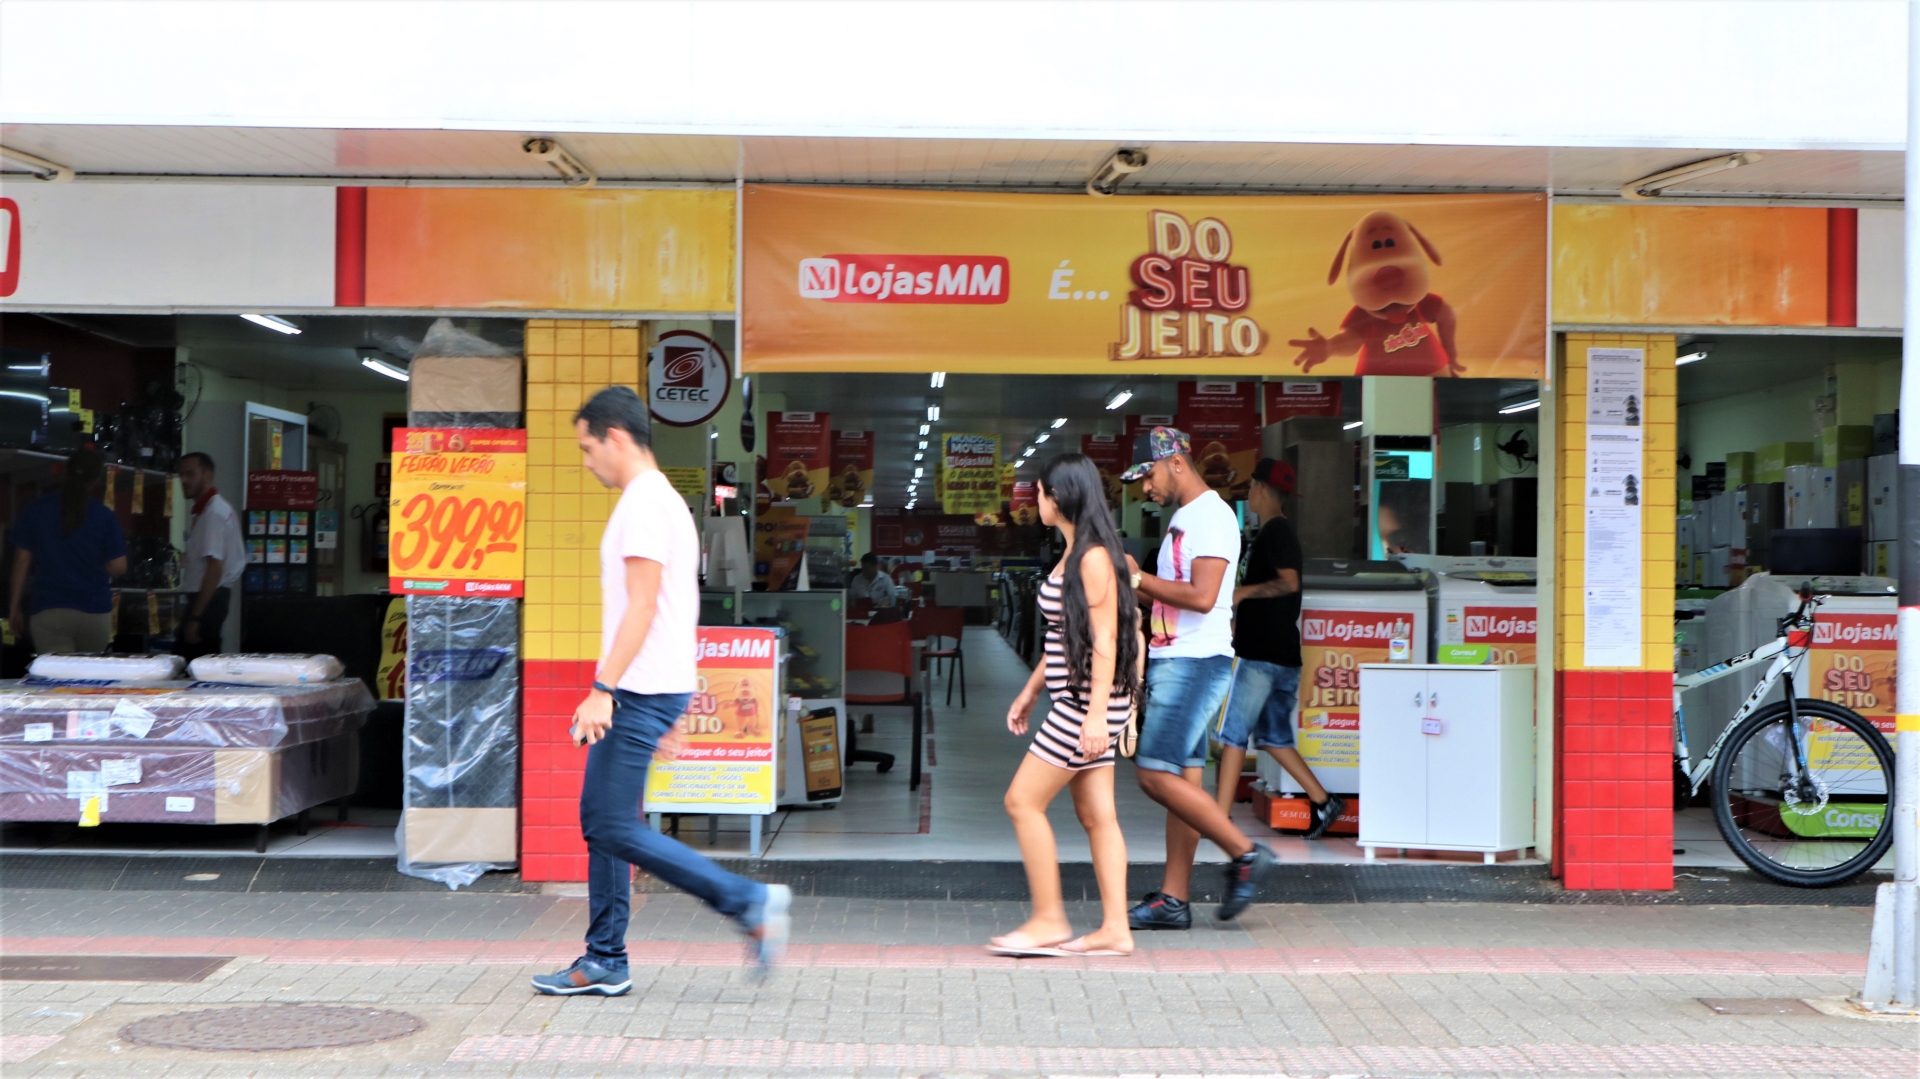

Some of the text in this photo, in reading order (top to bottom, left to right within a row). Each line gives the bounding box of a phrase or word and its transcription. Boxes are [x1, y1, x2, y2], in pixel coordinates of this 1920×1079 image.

[1148, 209, 1233, 263] DO
[1047, 259, 1110, 300] É...
[1132, 254, 1250, 311] SEU
[1112, 304, 1264, 358] JEITO
[656, 387, 710, 402] CETEC
[391, 493, 524, 571] 399,90
[695, 638, 771, 662] jasMM
[1325, 650, 1355, 671] DO
[1833, 653, 1864, 673] DO
[1317, 667, 1360, 688] SEU
[1826, 669, 1872, 691] SEU
[1329, 718, 1357, 728] pague
[681, 748, 712, 758] pague
[713, 746, 725, 757] do
[727, 749, 744, 757] seu
[1280, 810, 1297, 818] SEM
